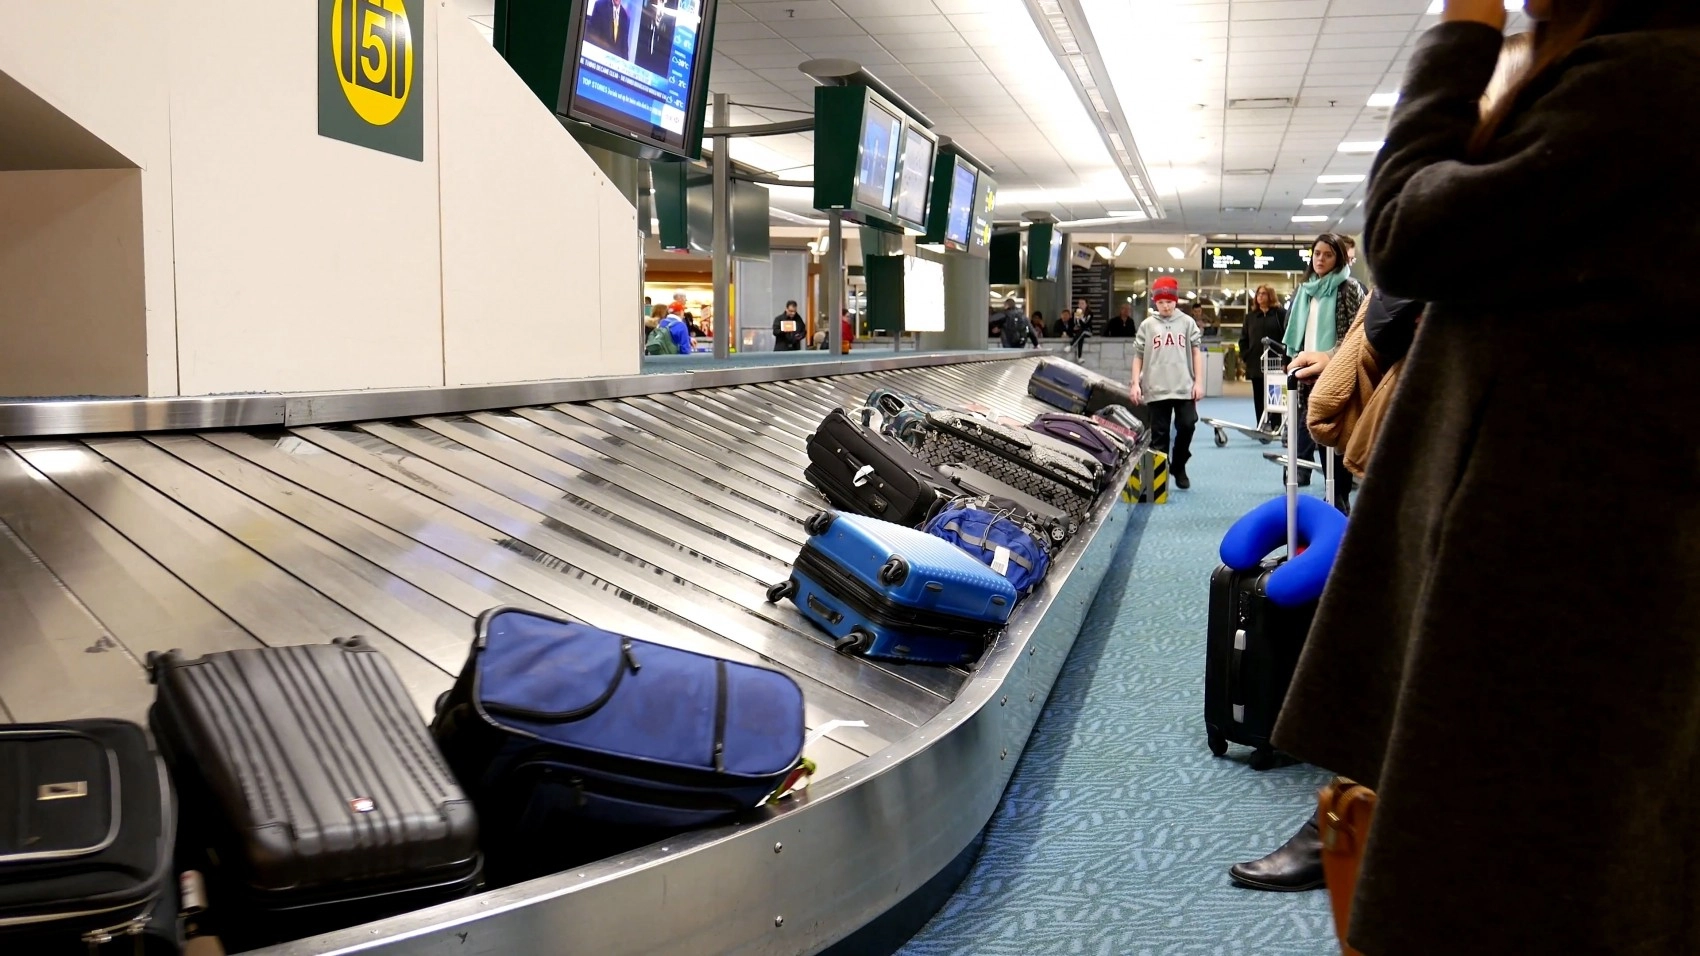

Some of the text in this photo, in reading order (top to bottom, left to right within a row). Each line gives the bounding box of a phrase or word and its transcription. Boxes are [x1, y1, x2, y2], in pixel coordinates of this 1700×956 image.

[360, 9, 388, 84] 5
[582, 76, 608, 94] TOP STORIES
